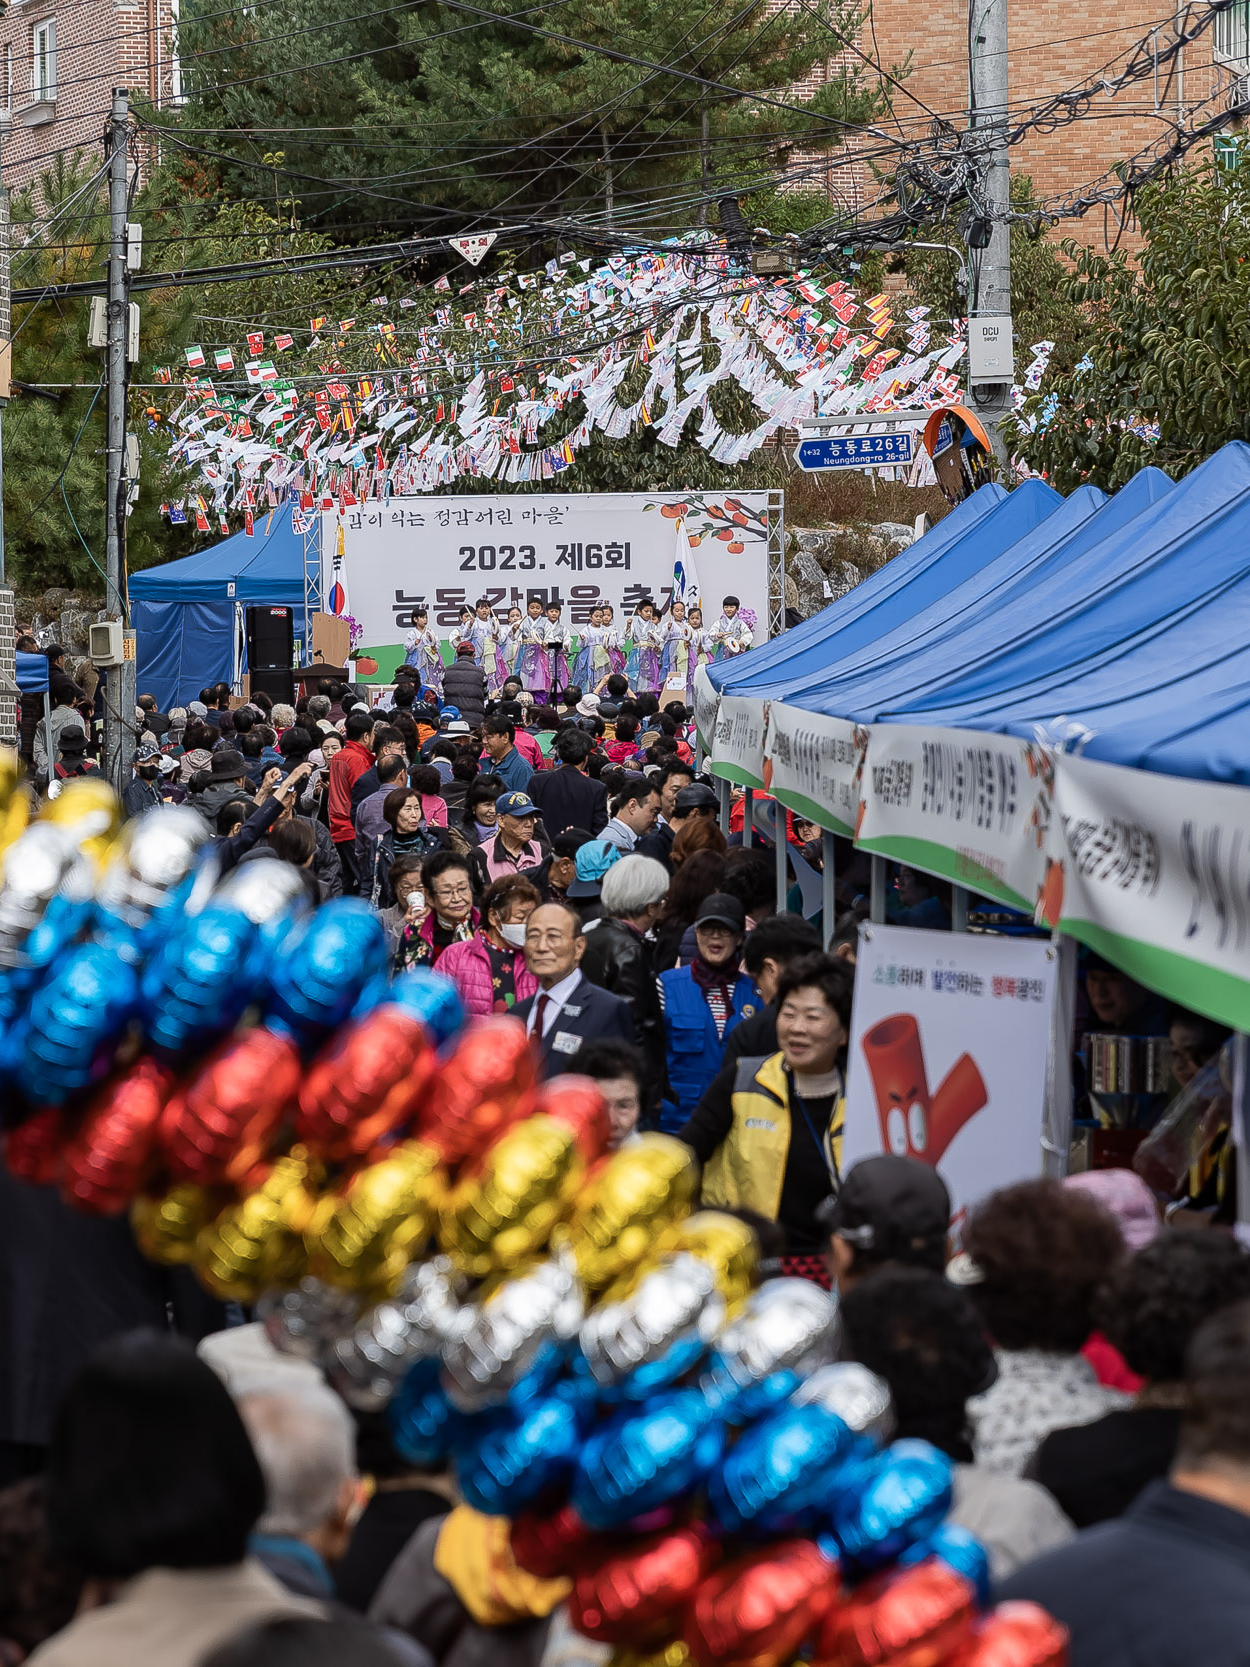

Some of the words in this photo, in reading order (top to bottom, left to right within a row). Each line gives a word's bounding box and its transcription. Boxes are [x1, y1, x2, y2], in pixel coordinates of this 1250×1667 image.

[982, 326, 999, 336] DCU
[829, 435, 908, 457] 능동로26길
[823, 453, 884, 465] Neungdong-ro
[885, 451, 910, 462] 26-gil
[348, 511, 382, 530] 감이
[391, 509, 426, 528] 익는
[434, 507, 513, 527] 정감어린
[458, 545, 546, 571] 2023.
[555, 541, 632, 571] 제6회
[392, 587, 467, 628] 능동
